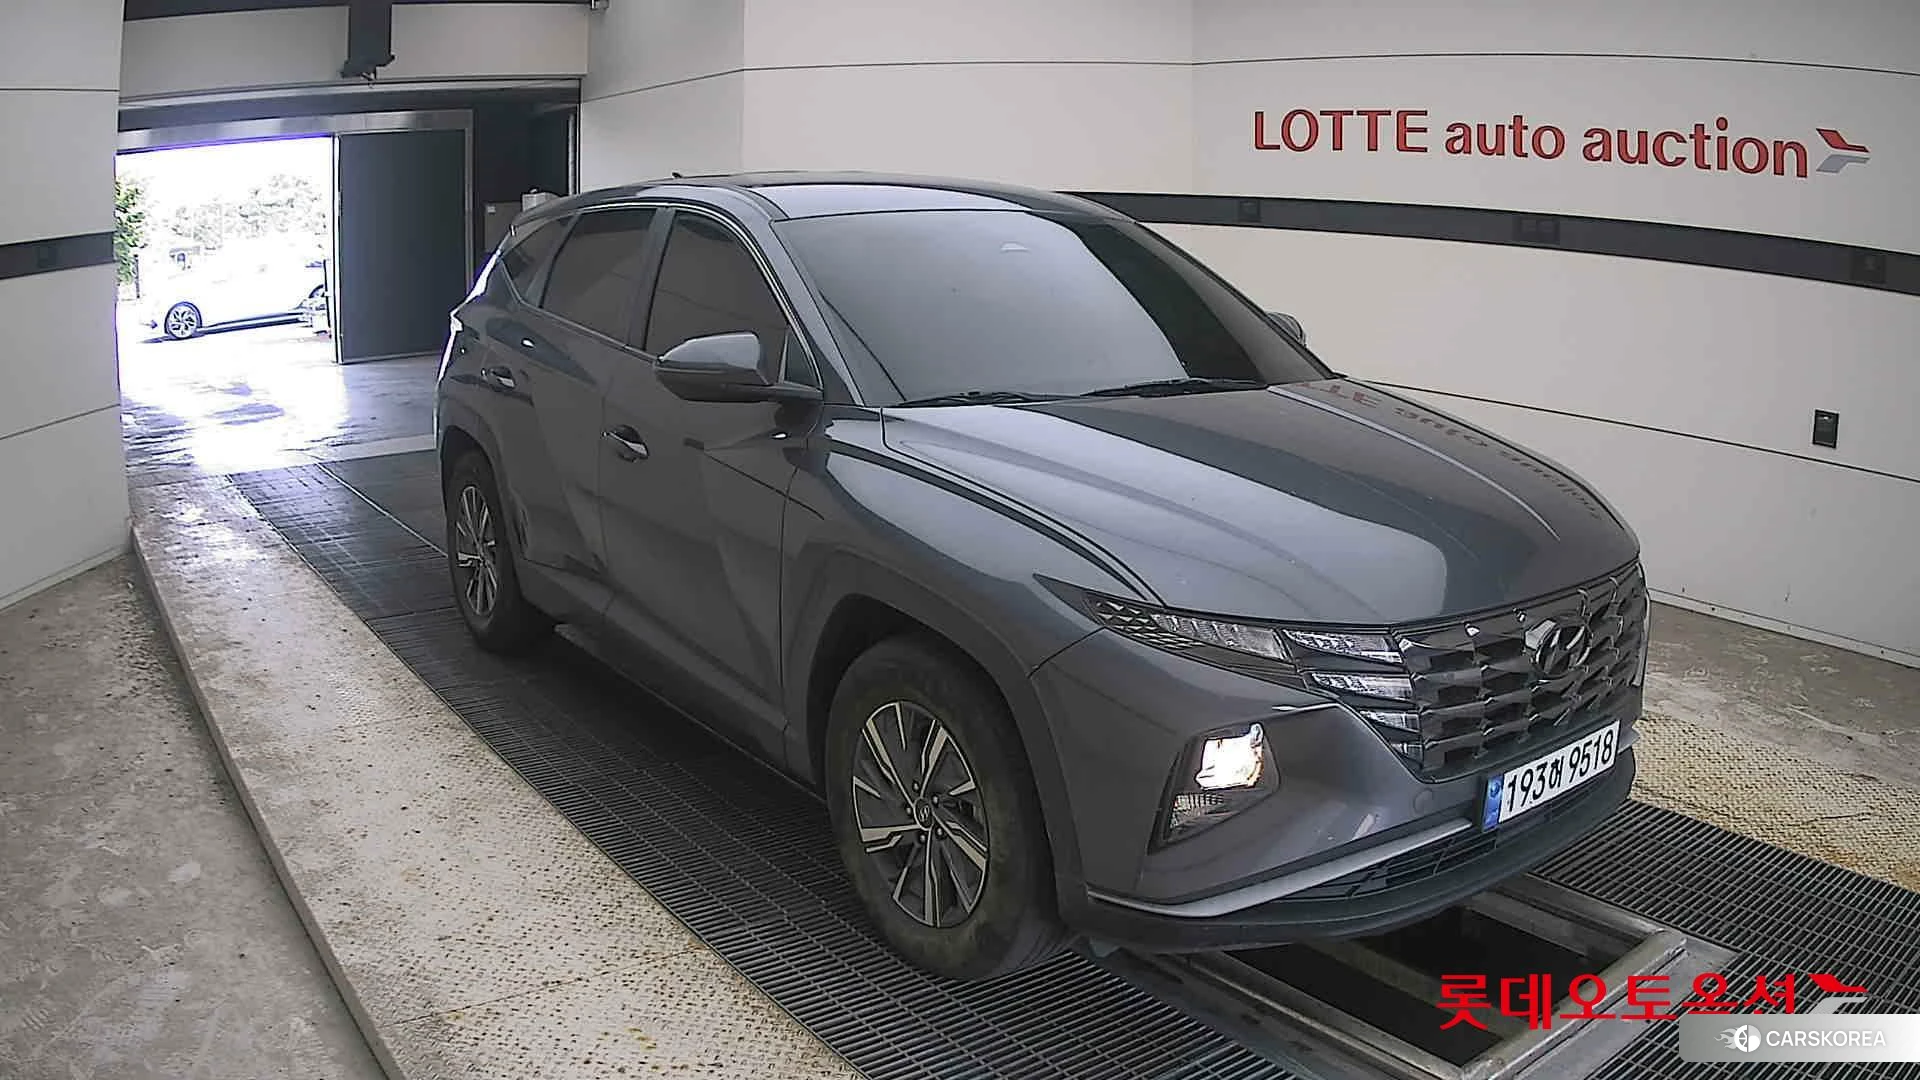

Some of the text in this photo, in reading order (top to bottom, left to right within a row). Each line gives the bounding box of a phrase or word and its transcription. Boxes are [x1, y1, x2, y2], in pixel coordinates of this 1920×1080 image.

[1254, 110, 1808, 178] LOTTE auto auction
[1507, 730, 1613, 812] 193허 9518
